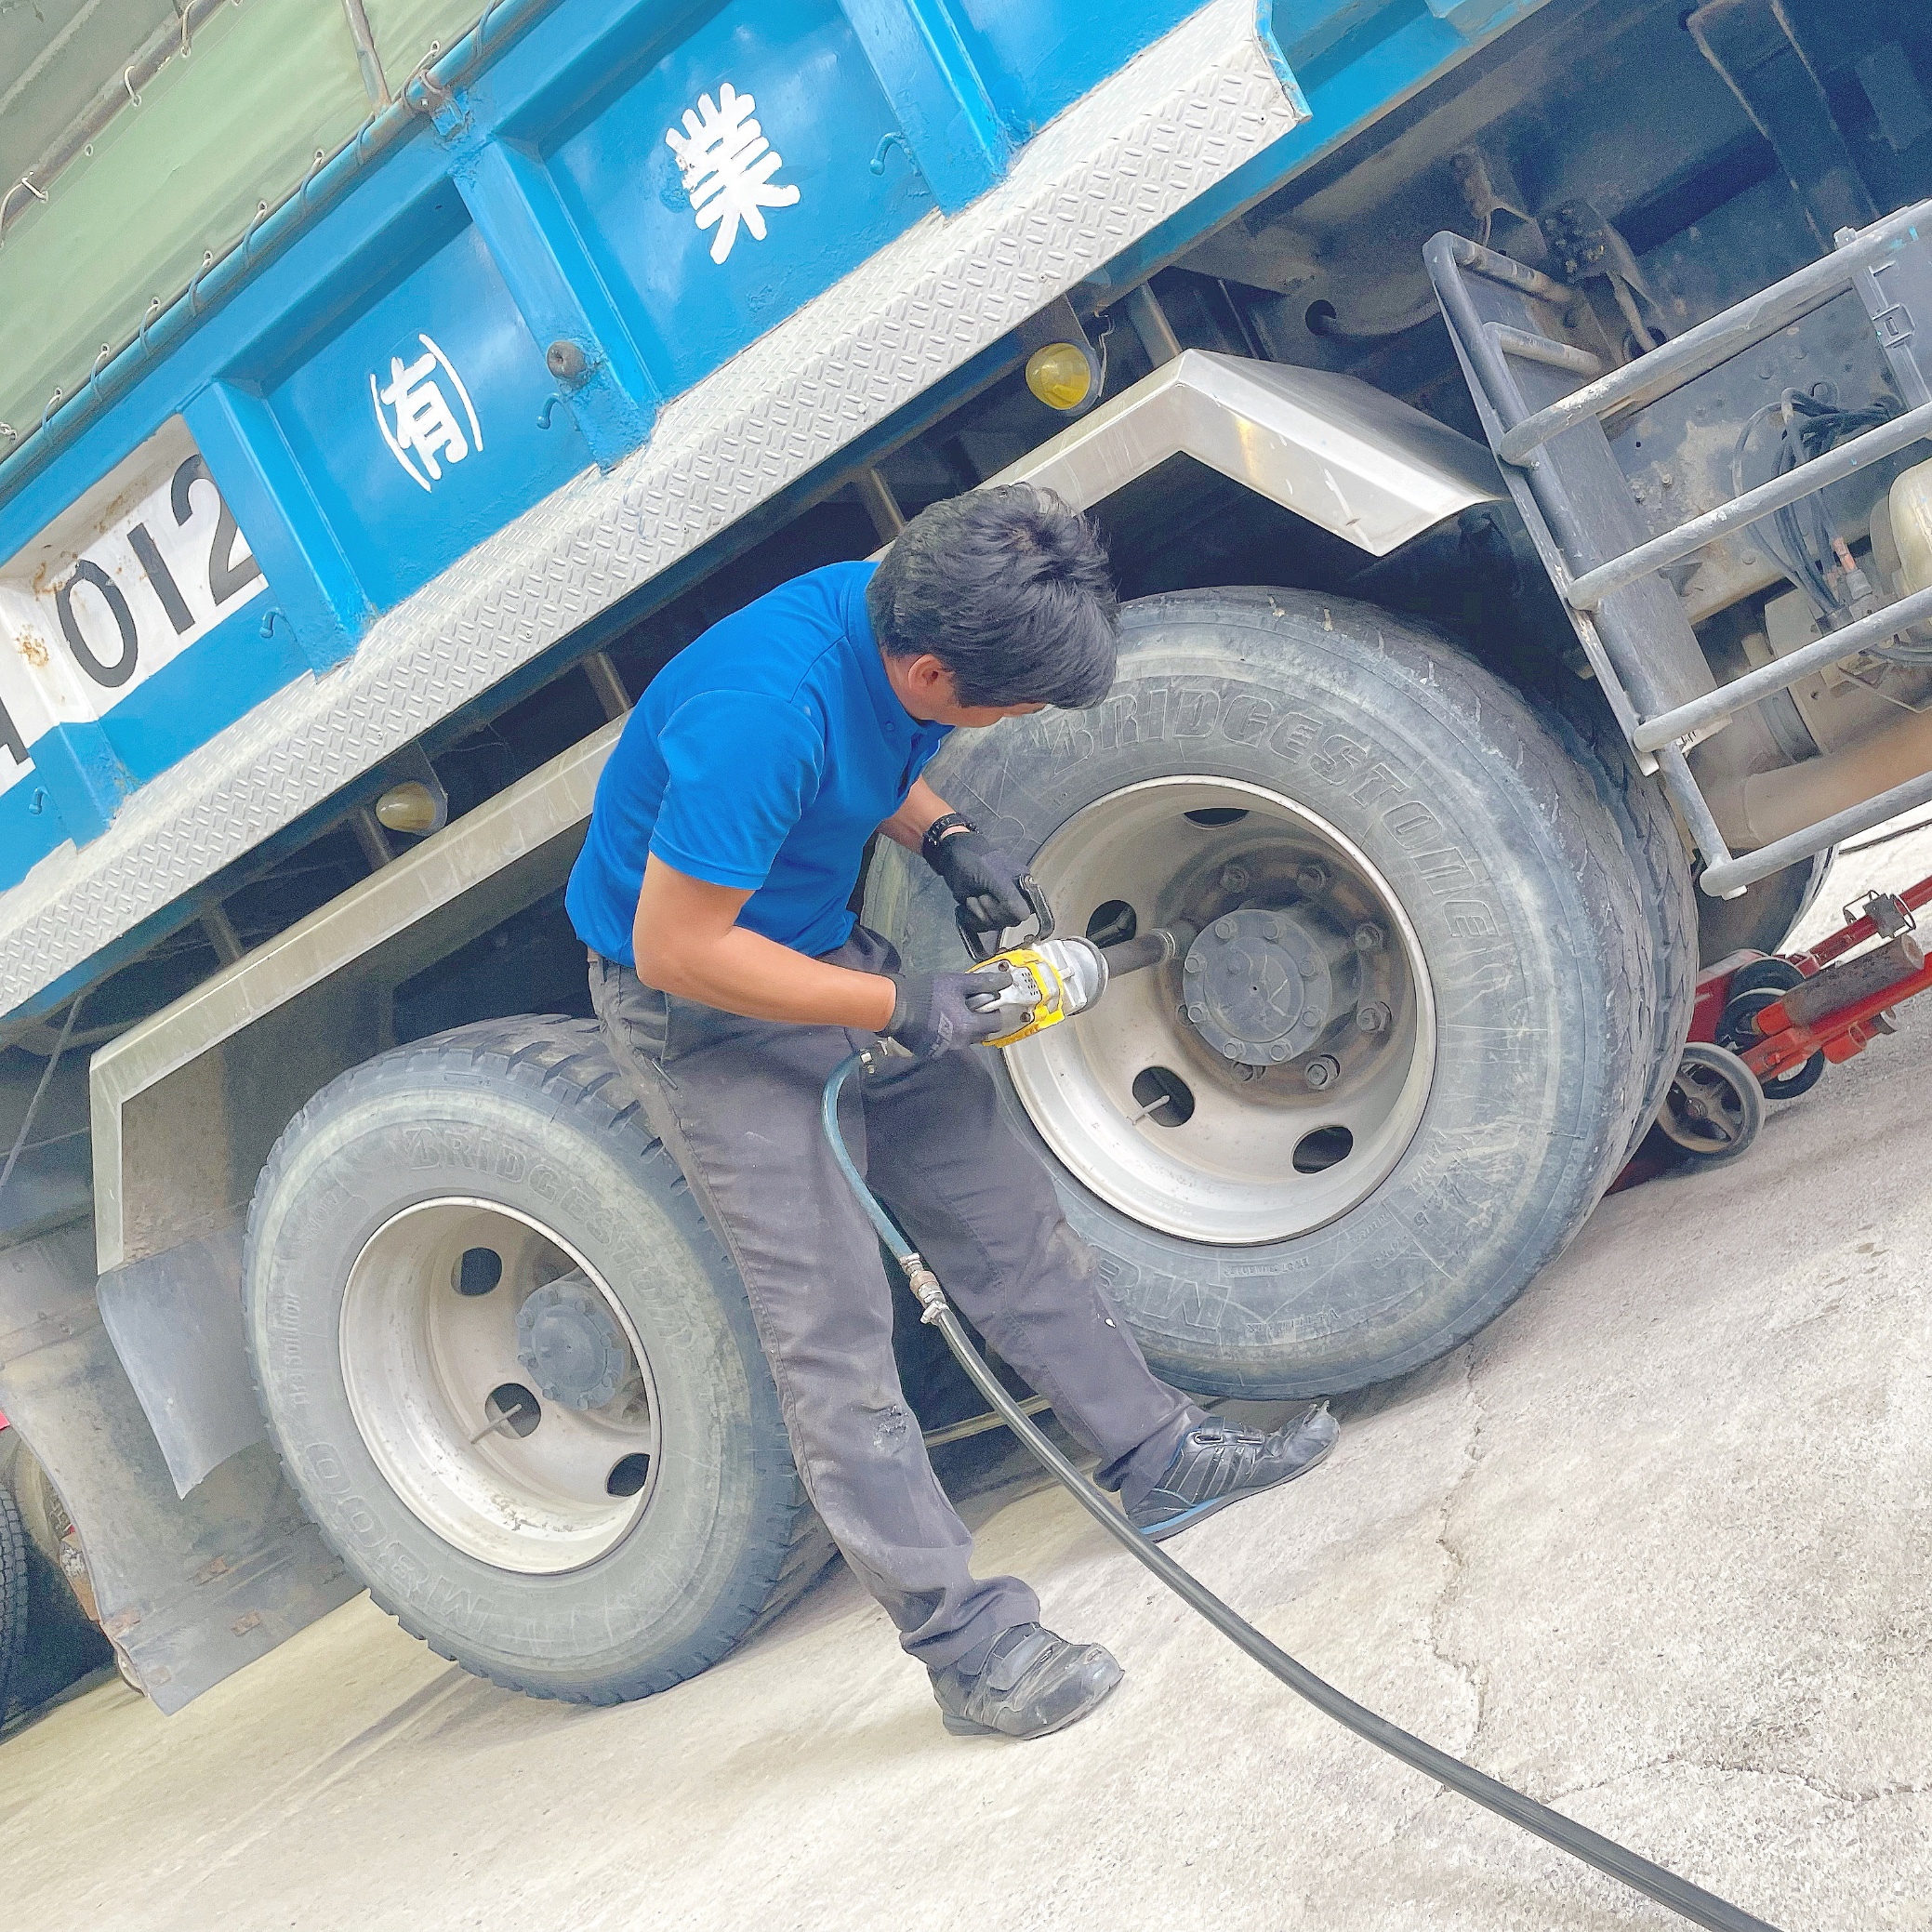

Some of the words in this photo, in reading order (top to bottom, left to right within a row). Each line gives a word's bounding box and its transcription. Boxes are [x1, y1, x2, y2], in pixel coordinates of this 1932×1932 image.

[664, 81, 802, 266] 業
[369, 333, 484, 494] (有)
[54, 453, 263, 688] 012
[1039, 687, 1500, 940] BRIDGESTONE
[400, 1125, 702, 1372] BRIDGESTONE
[303, 1440, 496, 1633] M800
